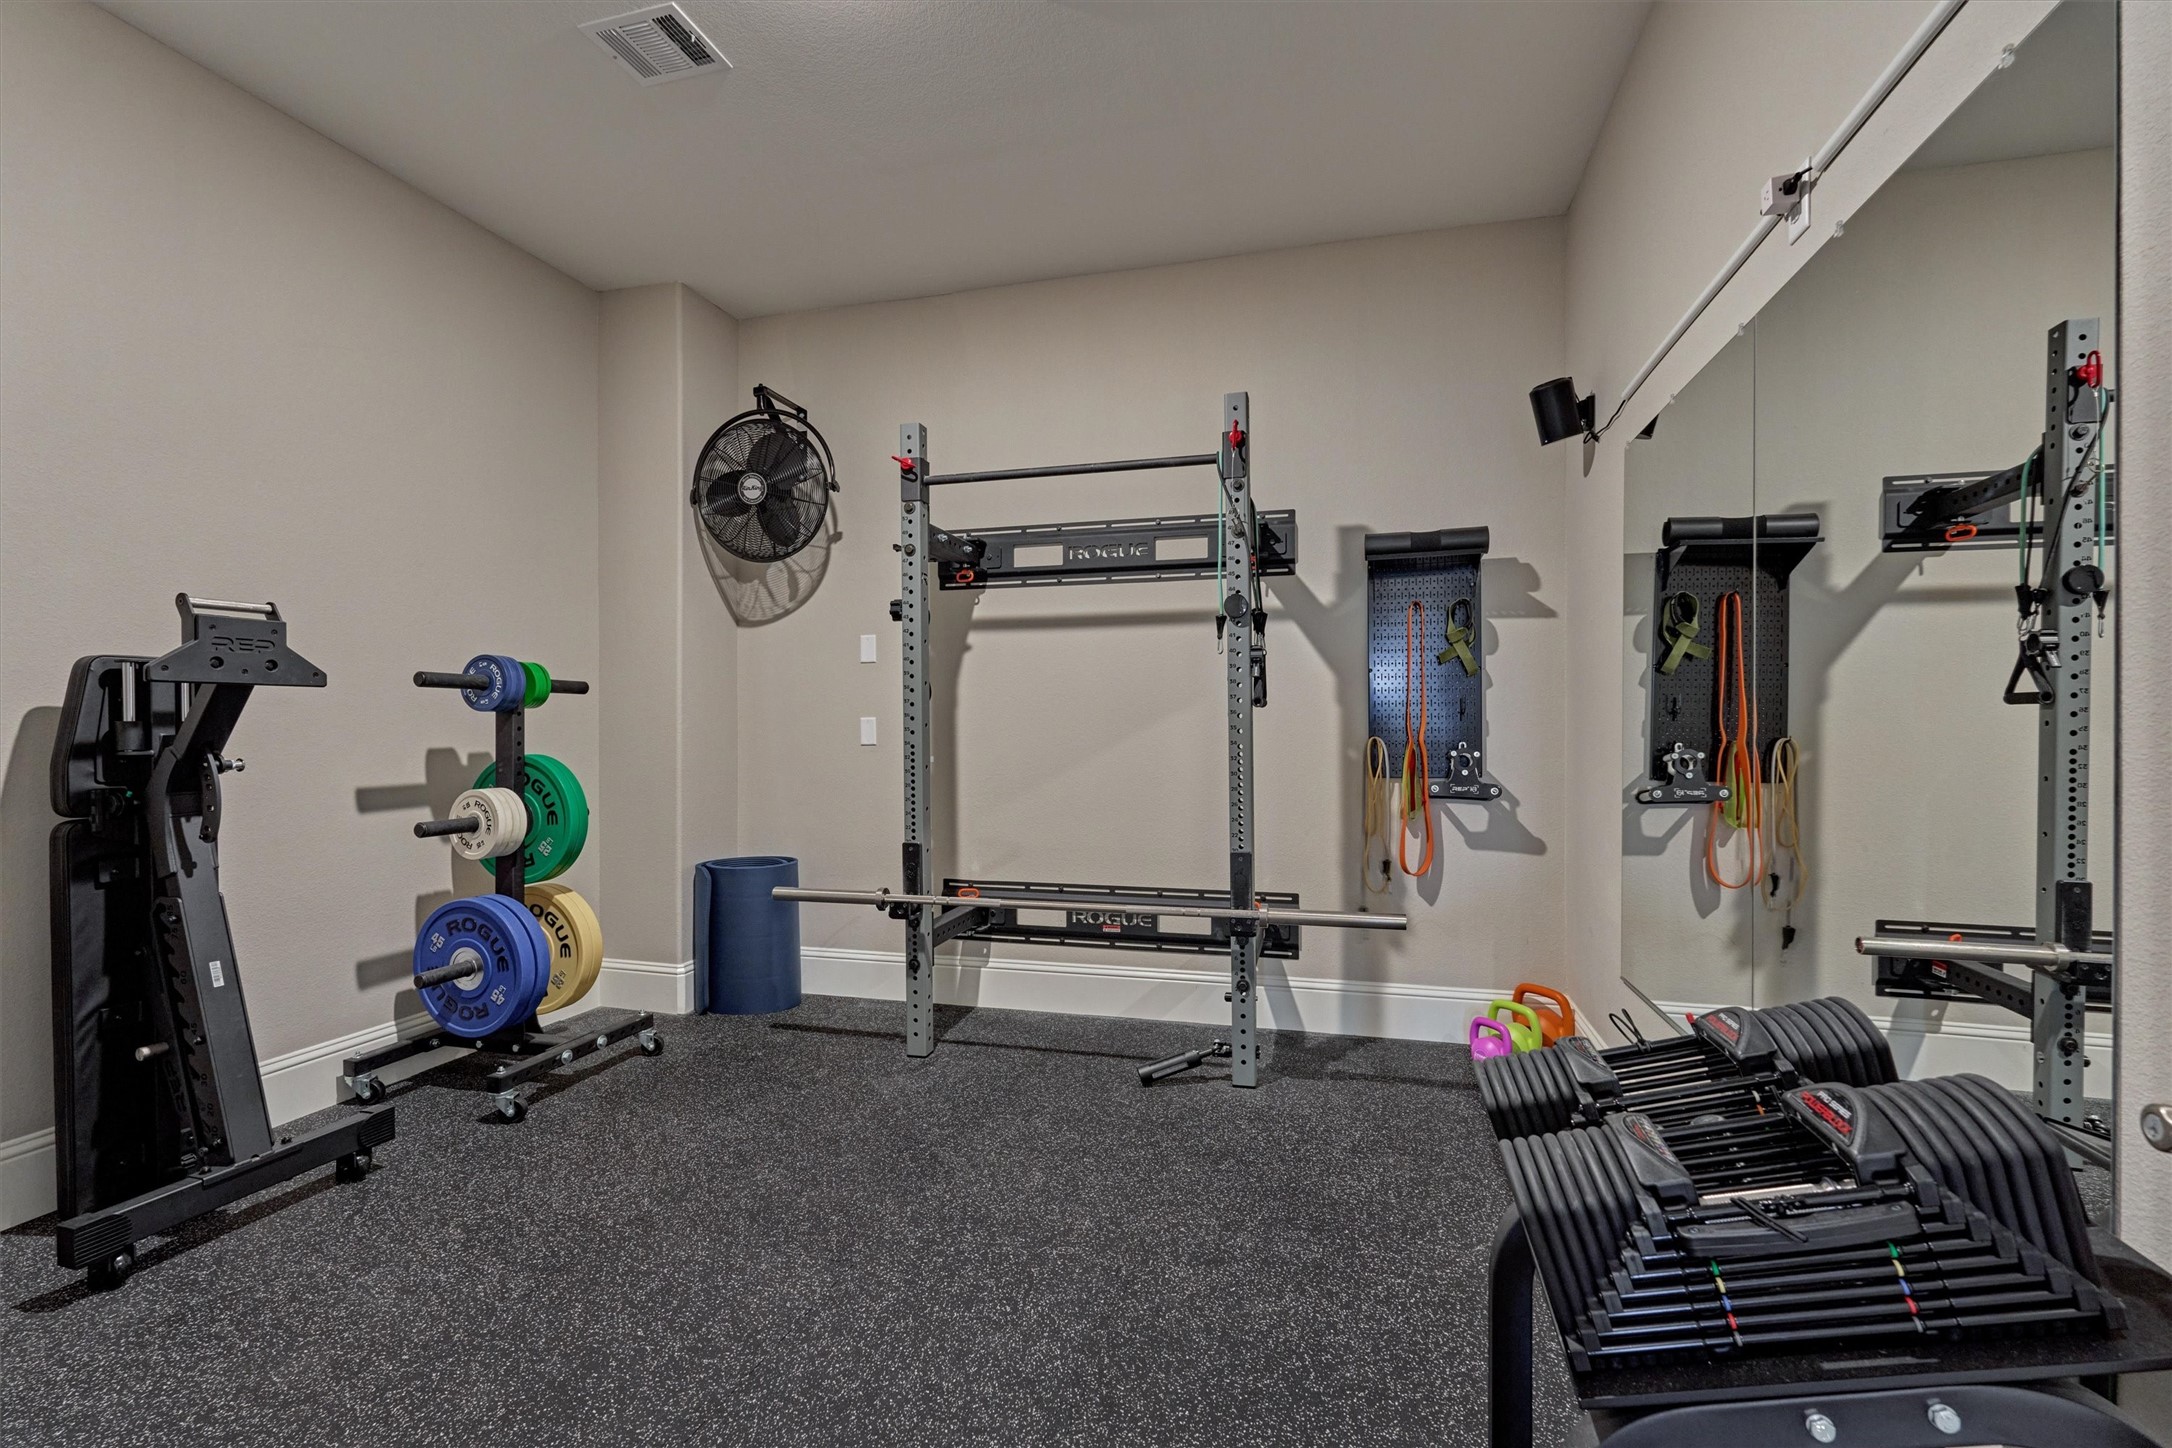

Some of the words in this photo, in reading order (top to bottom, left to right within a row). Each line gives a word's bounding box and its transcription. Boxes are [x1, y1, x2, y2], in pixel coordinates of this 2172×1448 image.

[1068, 542, 1148, 560] ROGUE
[211, 636, 276, 653] REP
[490, 664, 502, 699] ROGUE
[524, 772, 558, 826] OGUE
[474, 800, 492, 836] ROGUE
[527, 903, 571, 958] OGUE
[1071, 911, 1152, 927] ROGUE
[430, 932, 445, 949] 45
[445, 917, 510, 973] ROGUE
[490, 989, 505, 1006] 45
[1817, 1090, 1832, 1103] PRO
[1802, 1090, 1852, 1136] POWERBLOCK
